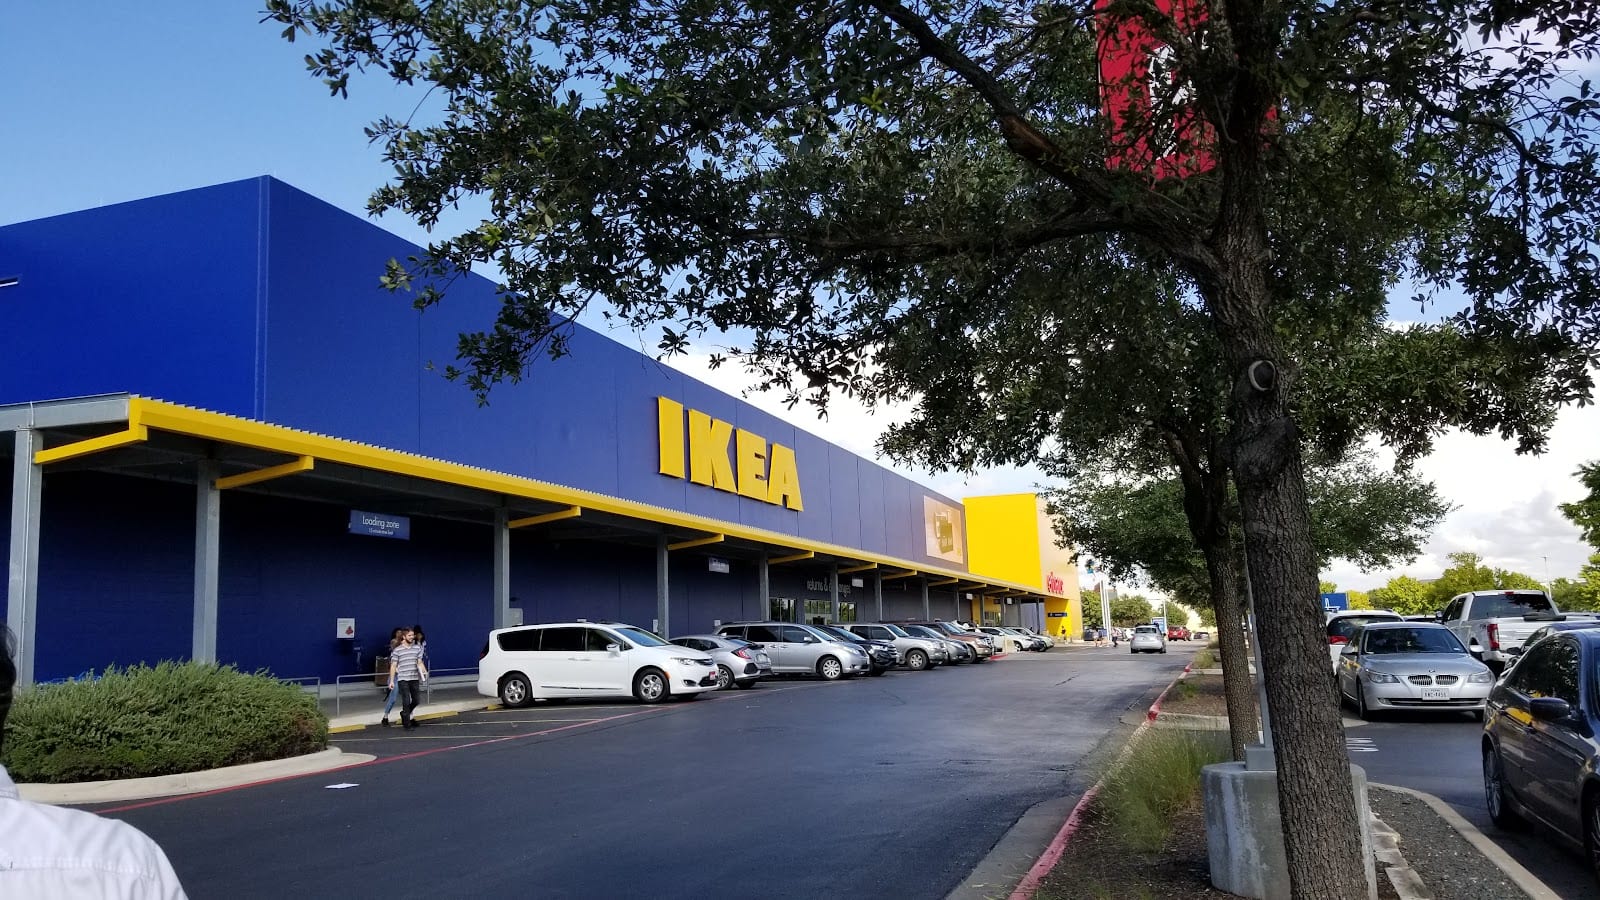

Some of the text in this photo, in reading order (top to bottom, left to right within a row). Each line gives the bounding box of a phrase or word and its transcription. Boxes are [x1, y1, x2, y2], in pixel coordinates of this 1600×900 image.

[658, 395, 804, 512] IKEA
[362, 514, 400, 530] Loading zone
